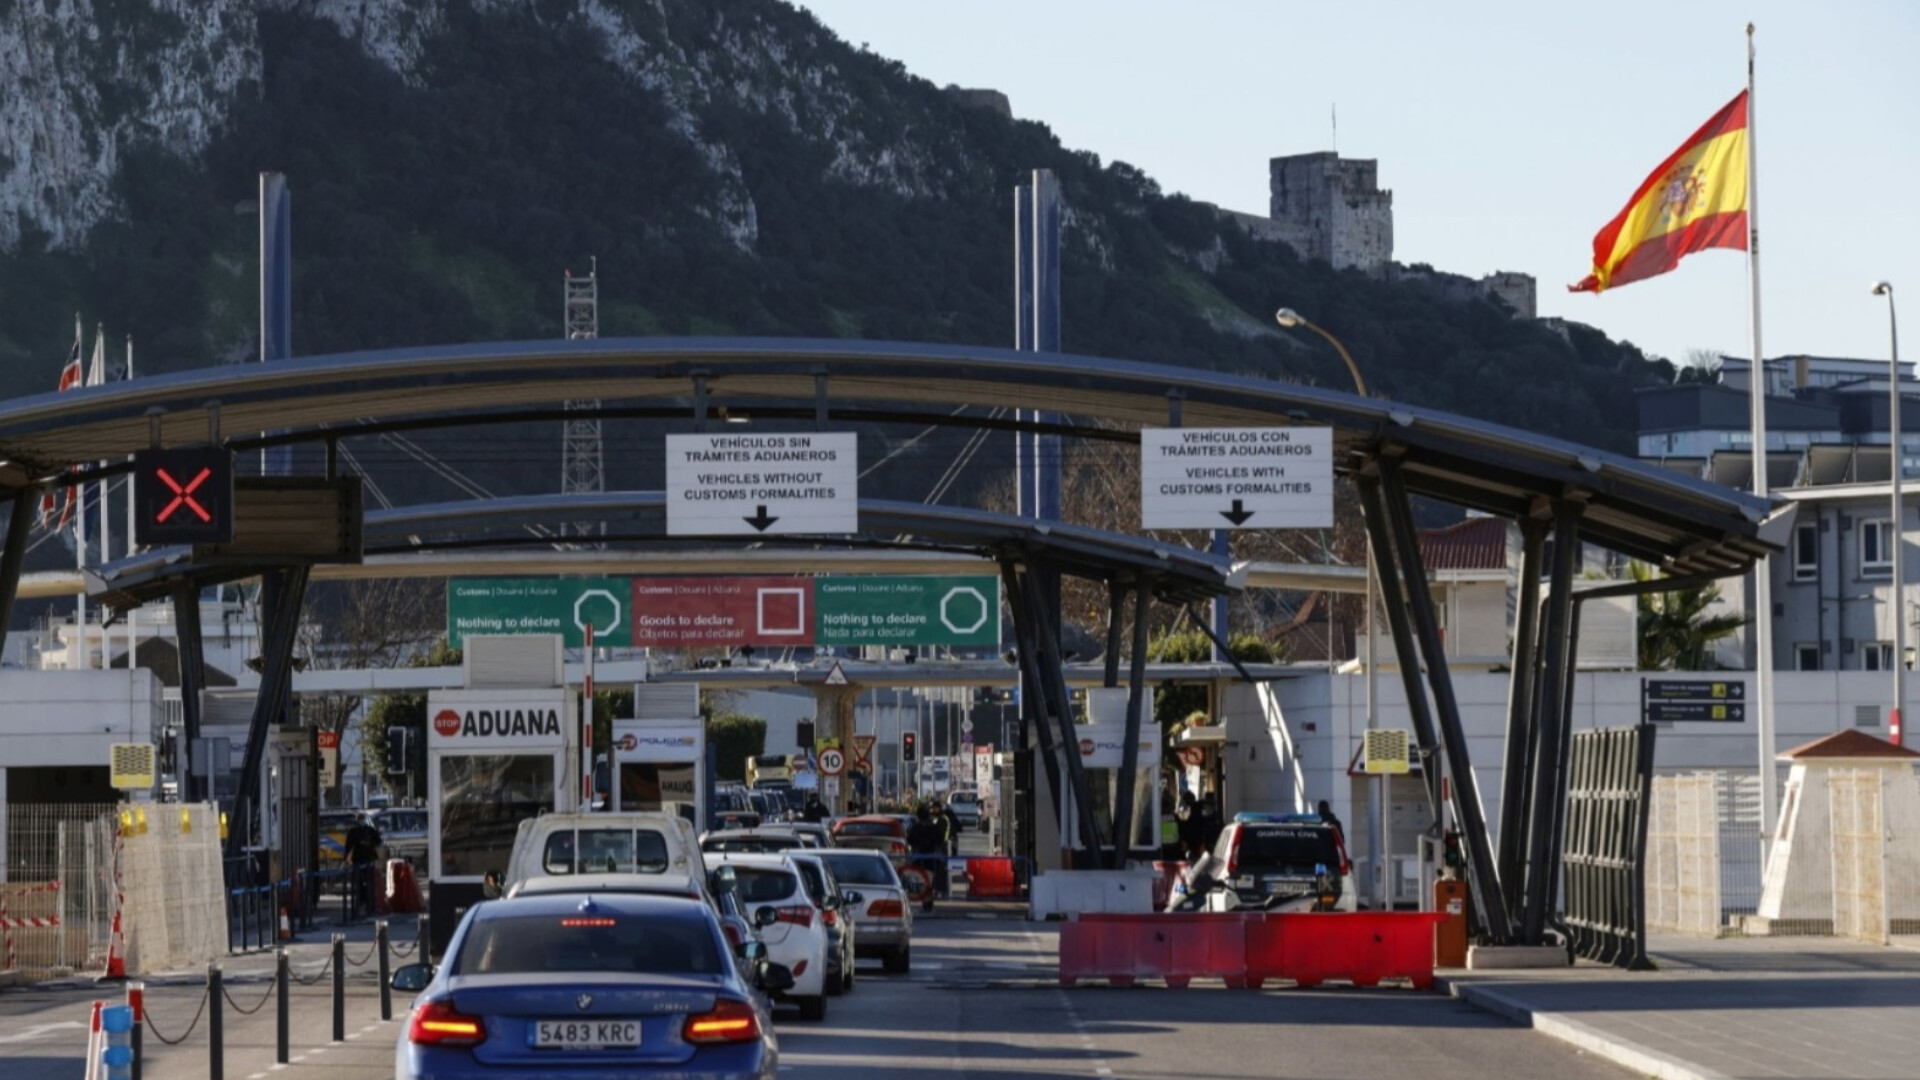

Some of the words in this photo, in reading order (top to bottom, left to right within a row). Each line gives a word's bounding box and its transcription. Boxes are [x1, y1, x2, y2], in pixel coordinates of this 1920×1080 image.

[711, 436, 785, 448] VEHÍCULOS
[789, 437, 811, 447] SIN
[1183, 431, 1257, 443] VEHÍCULOS
[1261, 432, 1290, 442] CON
[685, 449, 750, 462] TRÁMITES
[754, 450, 836, 461] ADUANEROS
[1160, 444, 1226, 456] TRÁMITES
[1229, 445, 1312, 456] ADUANEROS
[697, 473, 760, 484] VEHICLES
[764, 472, 822, 483] WITHOUT
[1186, 467, 1248, 478] VEHICLES
[1252, 467, 1284, 477] WITH
[684, 489, 747, 500] CUSTOMS
[751, 488, 835, 499] FORMALITIES
[1160, 484, 1223, 495] CUSTOMS
[1226, 483, 1312, 494] FORMALITIES
[457, 587, 490, 596] Customs
[639, 586, 673, 594] Customs
[822, 584, 857, 592] Customs
[457, 617, 502, 630] Nothing
[505, 617, 517, 627] to
[520, 616, 560, 627] declare
[639, 615, 676, 626] Goods
[679, 616, 690, 626] to
[693, 615, 734, 626] declare
[823, 614, 868, 626] Nothing
[872, 615, 883, 624] to
[886, 613, 926, 624] declare
[639, 628, 678, 641] Objetos
[680, 630, 703, 640] para
[705, 628, 744, 638] declarar
[823, 627, 849, 637] Nada
[852, 629, 875, 639] para
[877, 627, 917, 636] declarar
[434, 719, 460, 729] STOP
[462, 709, 560, 737] ADUANA
[823, 754, 840, 768] 10
[540, 1023, 591, 1043] 5483
[597, 1023, 636, 1042] KRC
